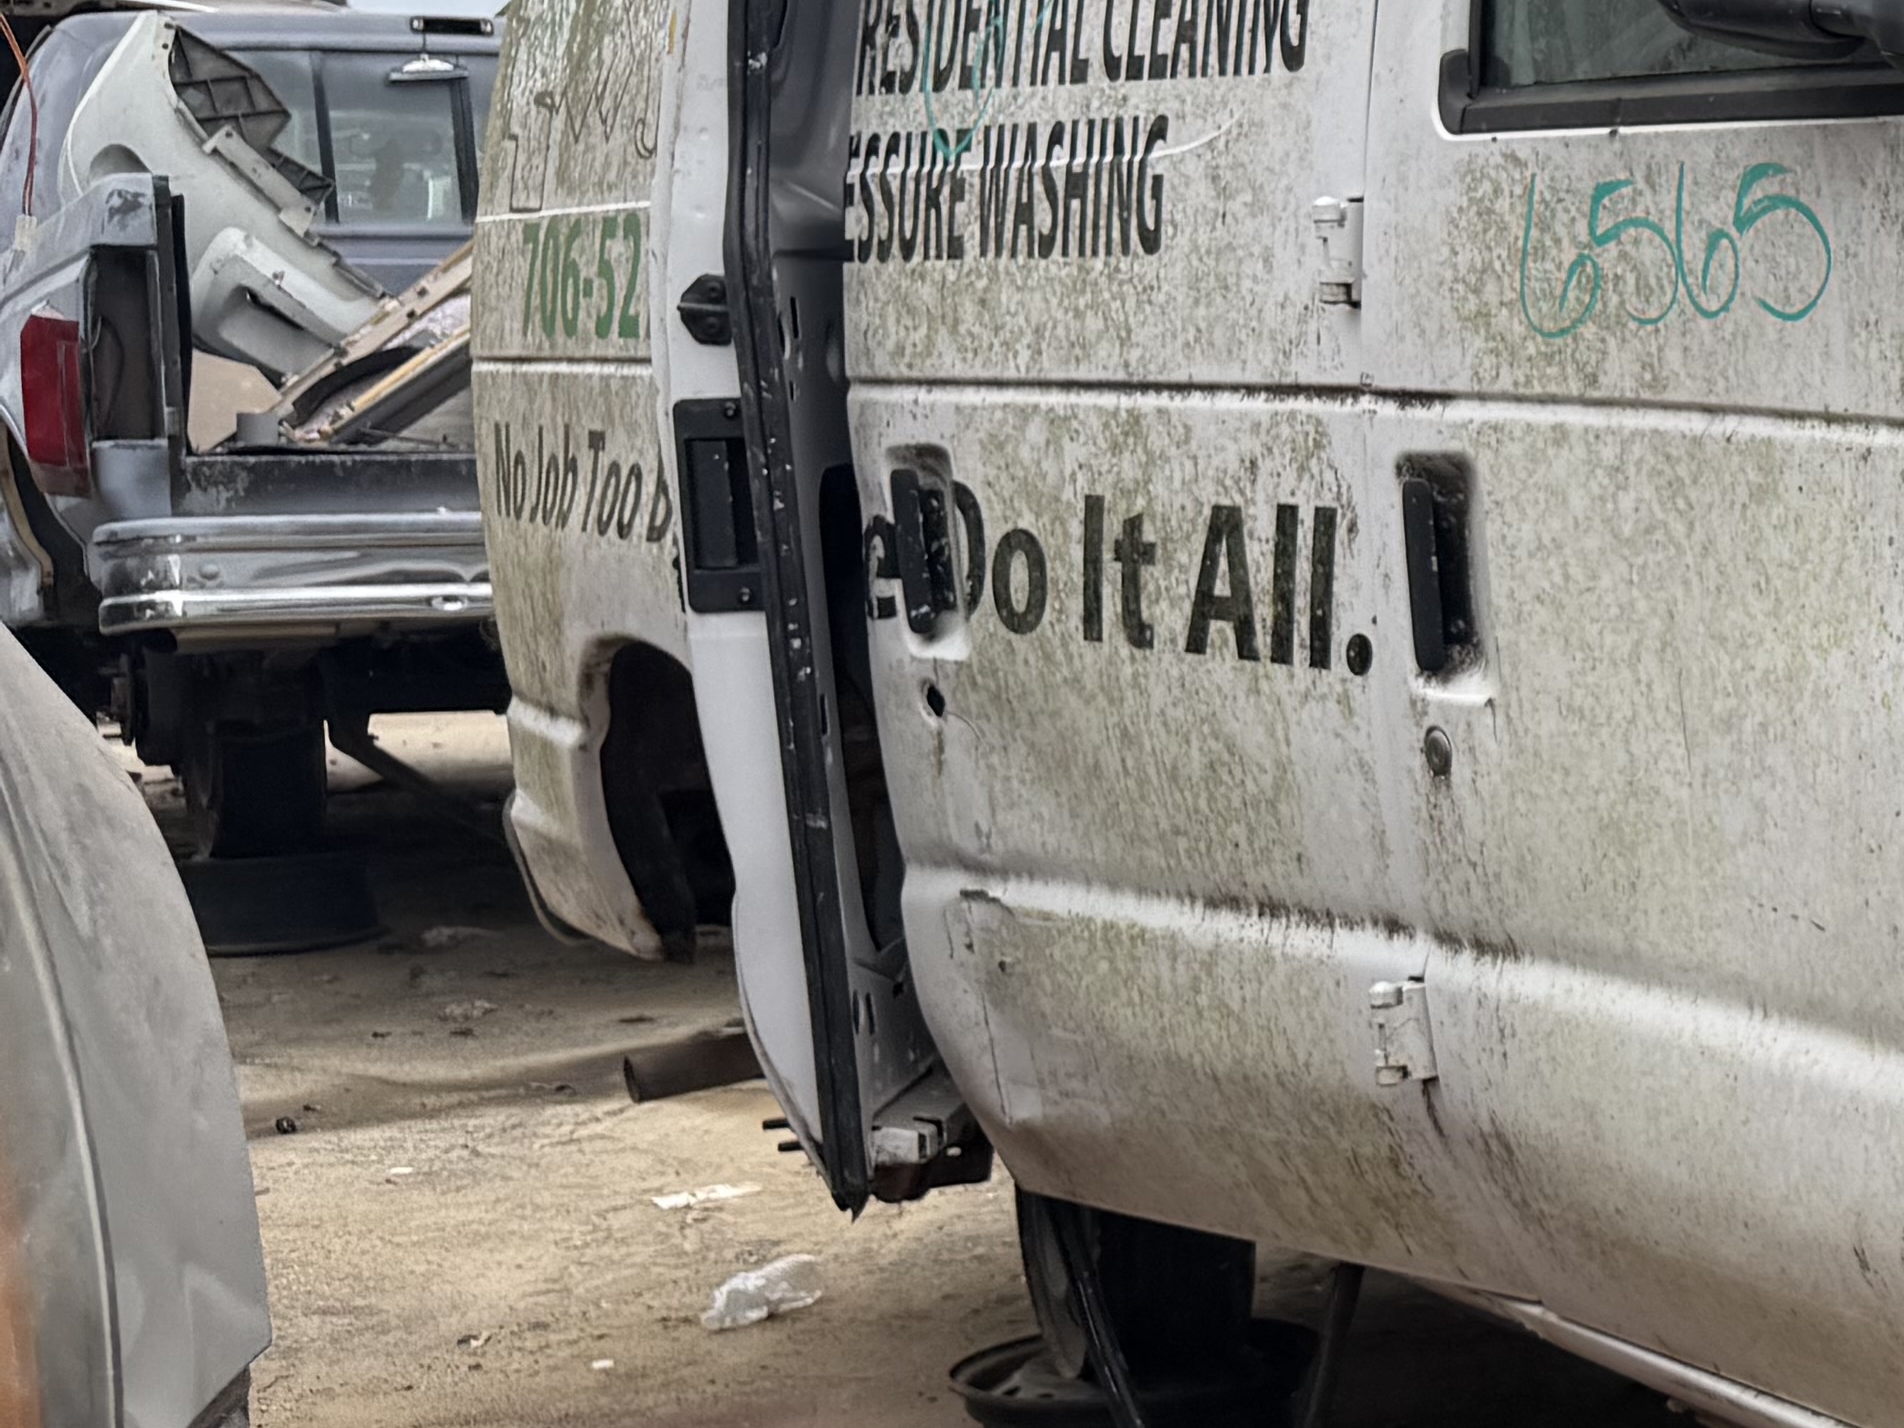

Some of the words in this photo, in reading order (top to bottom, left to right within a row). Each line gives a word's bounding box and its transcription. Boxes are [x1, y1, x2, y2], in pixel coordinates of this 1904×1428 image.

[980, 115, 1168, 259] WASHING
[1520, 161, 1832, 339] 6565
[495, 422, 526, 520] No
[529, 425, 578, 530] Job
[582, 429, 643, 540] Too
[1083, 495, 1156, 650] It
[1185, 504, 1373, 676] All.
